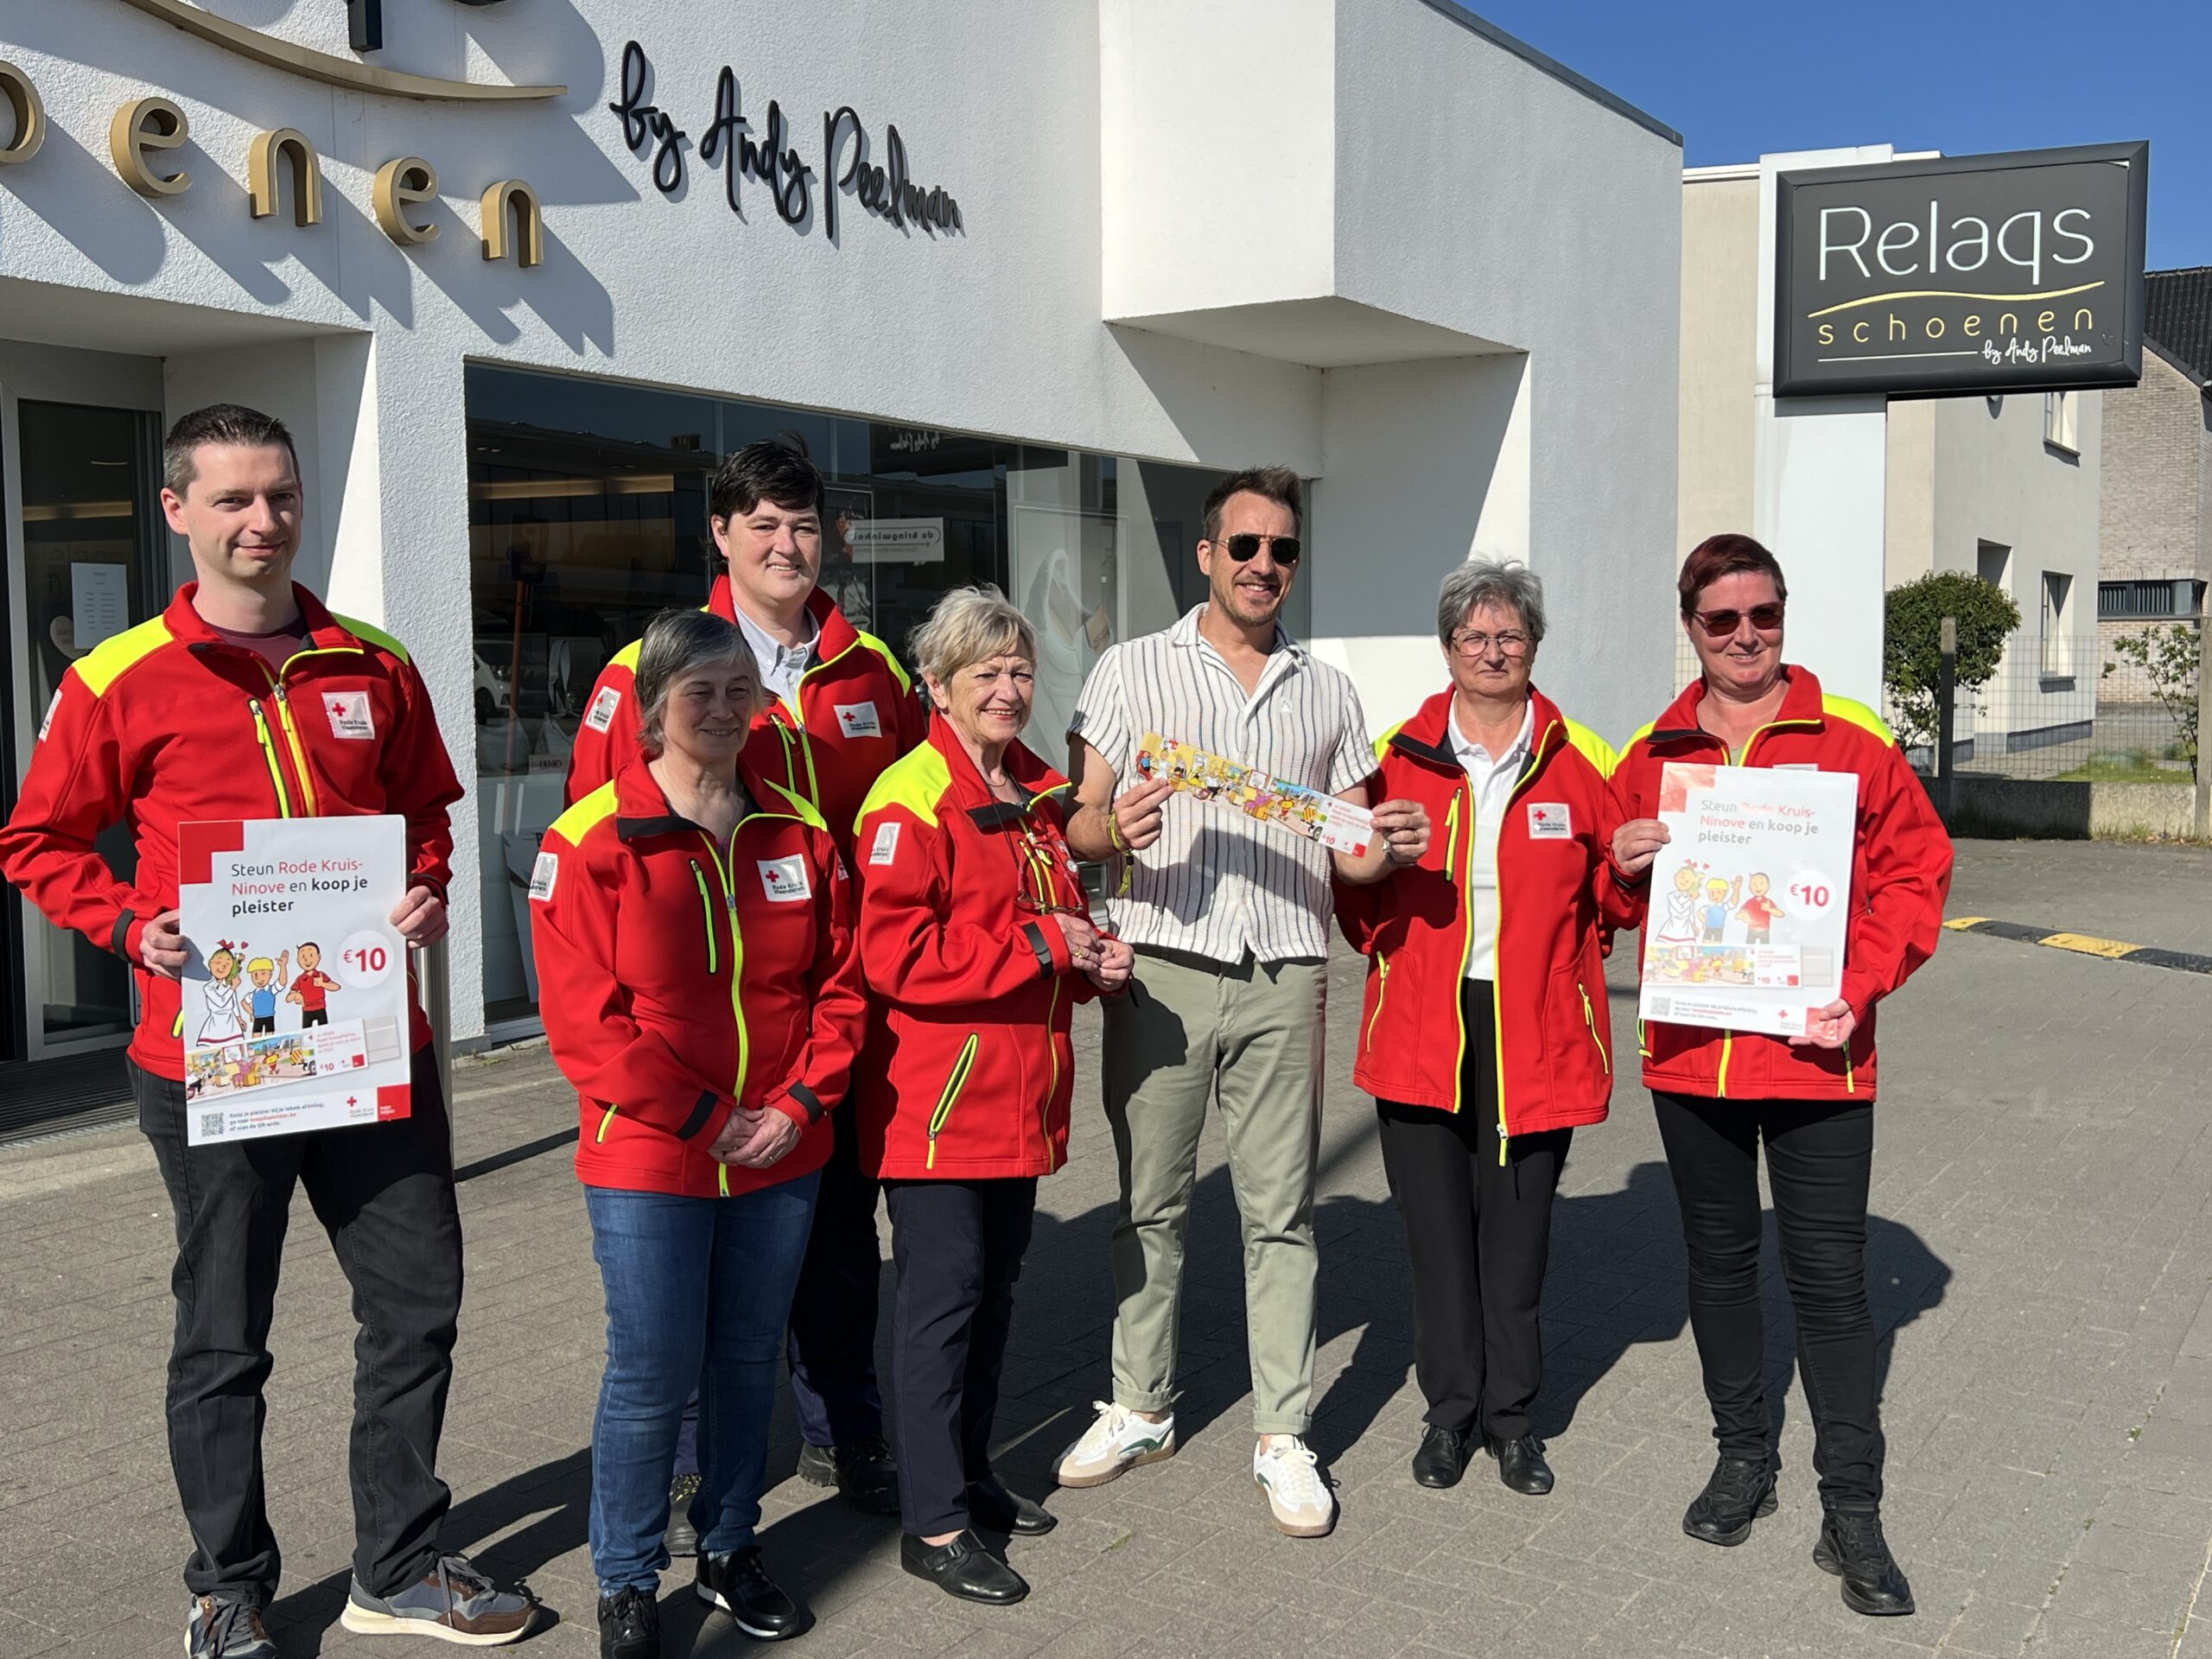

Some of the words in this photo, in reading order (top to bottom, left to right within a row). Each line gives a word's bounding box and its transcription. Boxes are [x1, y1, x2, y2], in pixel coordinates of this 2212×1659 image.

[609, 40, 685, 193] by
[699, 65, 811, 224] Andy
[823, 105, 962, 239] Peelman
[1819, 200, 2094, 285] Relaqs
[1818, 308, 2093, 345] schoenen
[1981, 339, 2002, 365] by
[2005, 336, 2039, 365] Andy
[2041, 334, 2092, 364] Peelman
[1701, 799, 1737, 812] Steun
[1778, 805, 1815, 818] Kruis-
[1700, 815, 1745, 829] Ninove
[1749, 821, 1764, 830] en
[1768, 819, 1802, 835] koop
[1804, 823, 1819, 836] je
[1699, 831, 1752, 844] pleister
[232, 863, 274, 877] Steun
[278, 860, 317, 874] Rode
[321, 858, 364, 872] Kruis-
[232, 881, 285, 895] Ninove
[289, 880, 307, 892] en
[312, 877, 350, 893] koop
[353, 875, 368, 892] je
[1789, 884, 1829, 906] €10
[232, 899, 295, 917] pleister
[343, 947, 387, 972] €10
